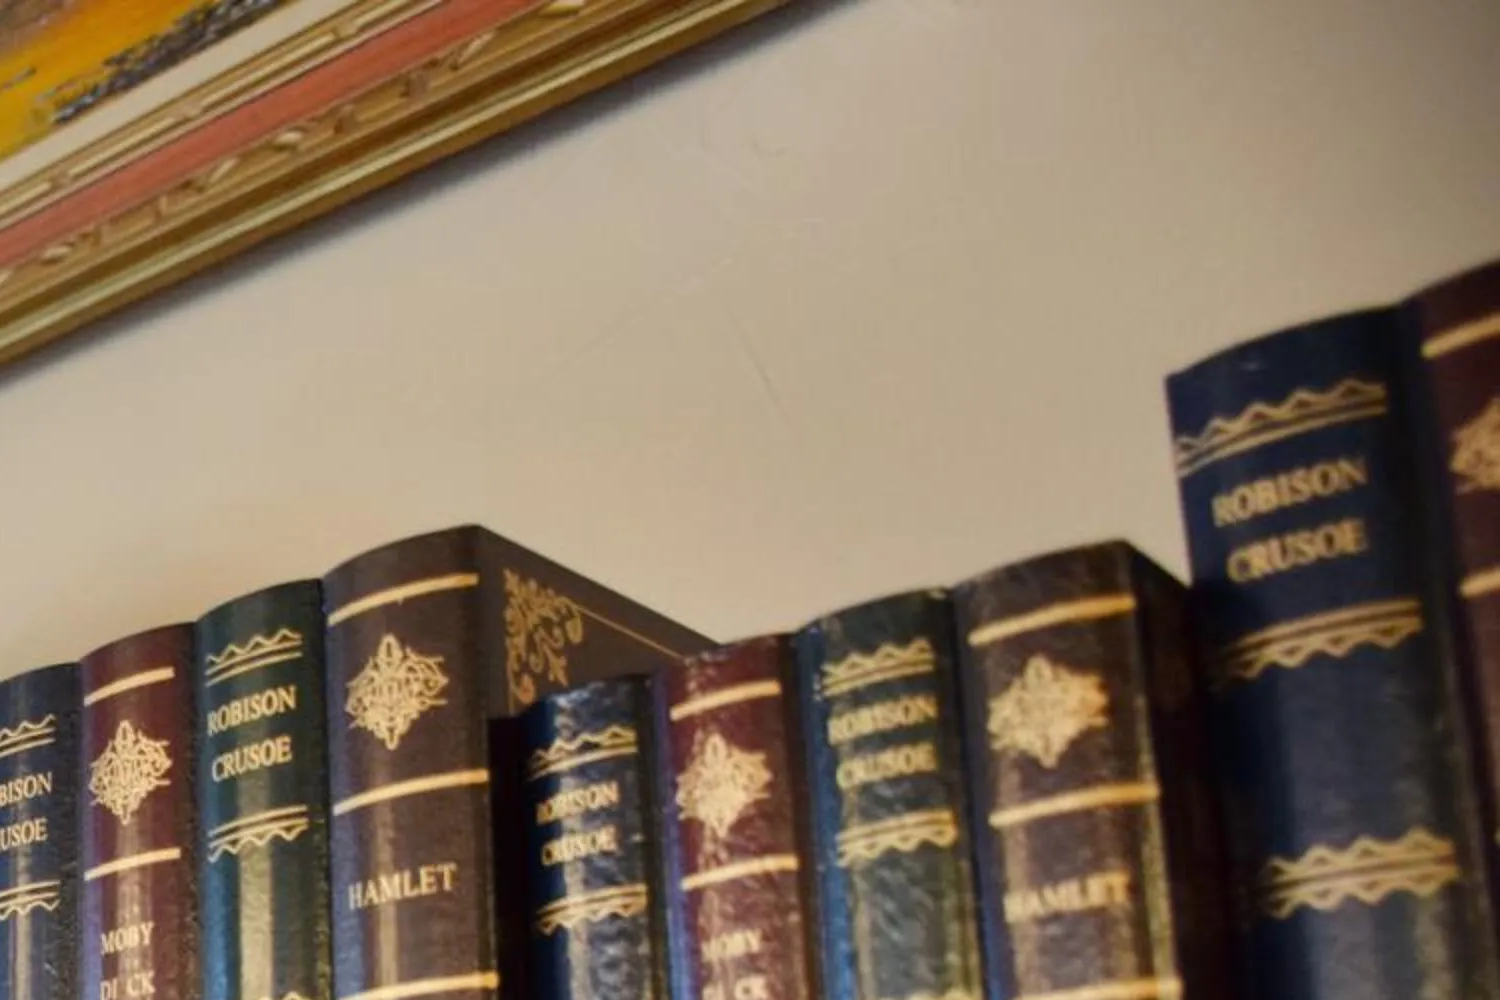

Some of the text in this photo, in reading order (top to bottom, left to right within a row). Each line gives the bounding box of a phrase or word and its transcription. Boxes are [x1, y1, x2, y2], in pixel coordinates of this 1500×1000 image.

[1211, 455, 1367, 528] ROBISON
[1226, 517, 1365, 584] CRUSOE
[207, 685, 296, 735] ROBISON
[211, 736, 292, 782] CRUSOE
[348, 862, 457, 910] HAMLET
[100, 920, 155, 957] MOBY
